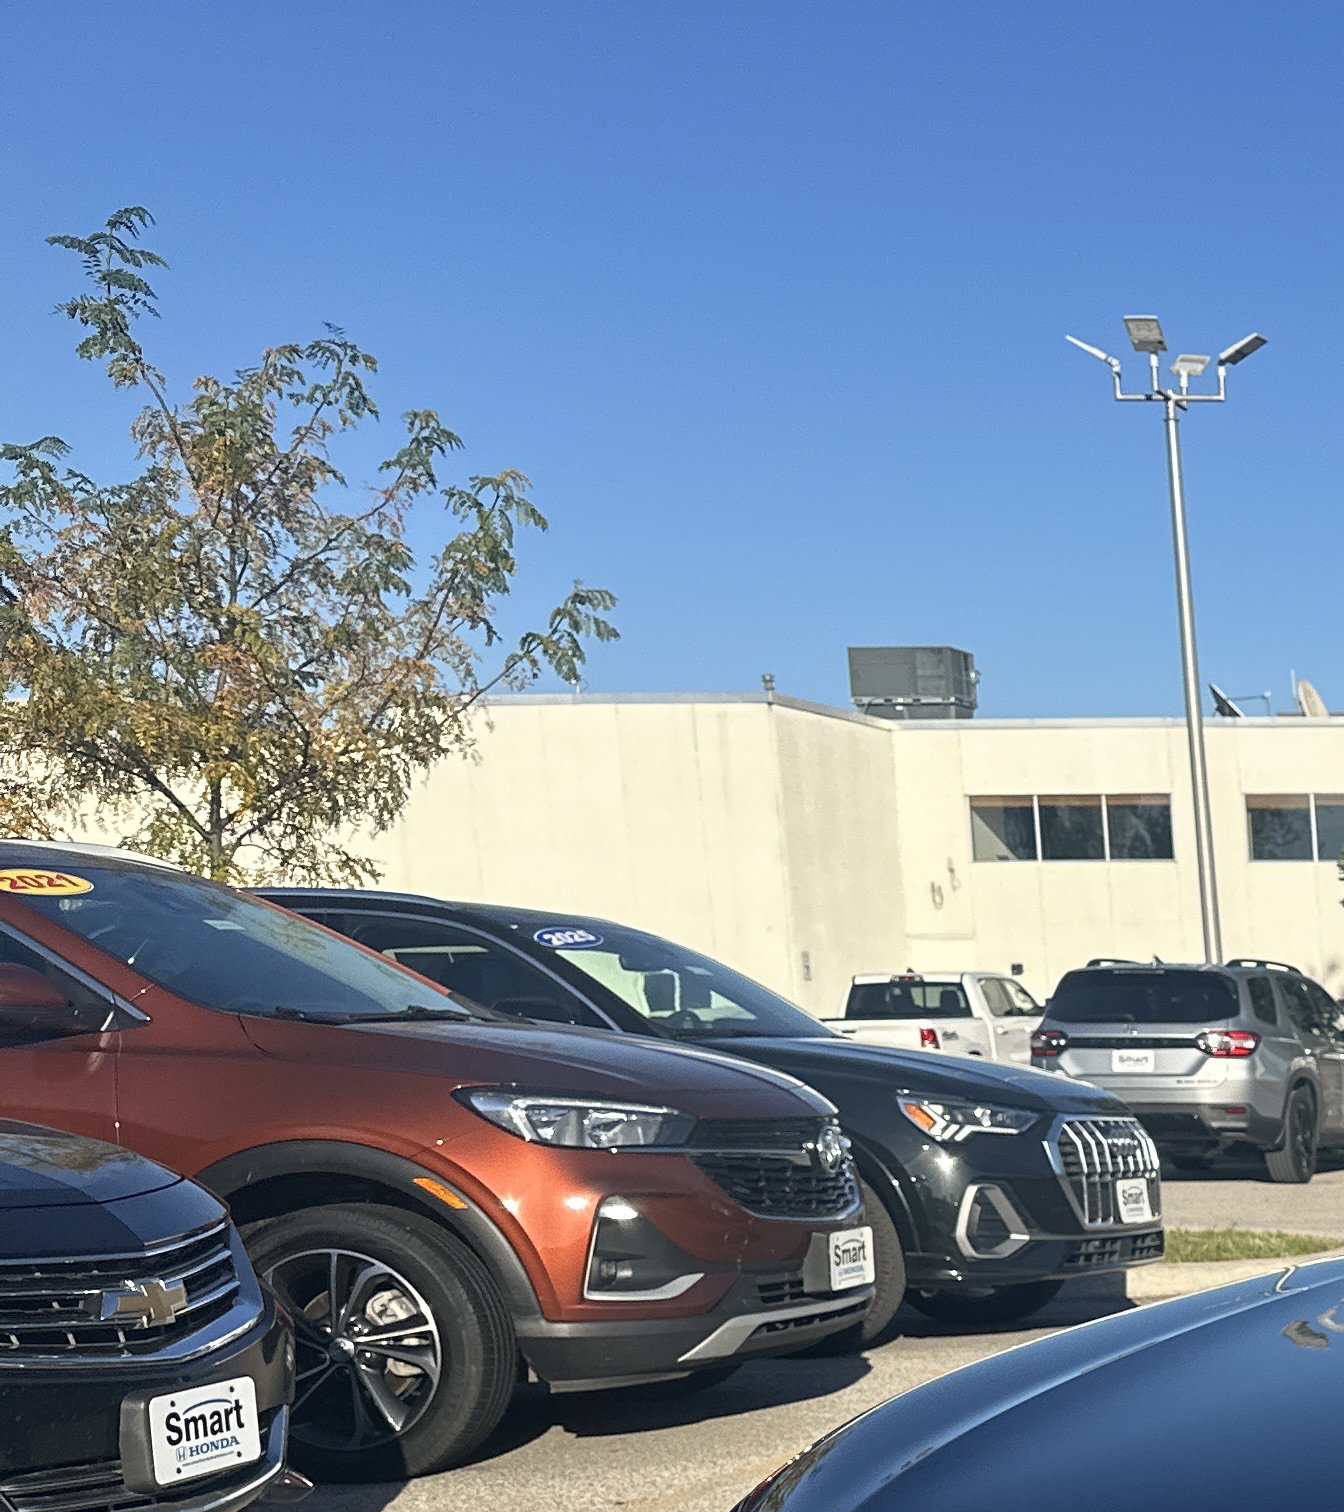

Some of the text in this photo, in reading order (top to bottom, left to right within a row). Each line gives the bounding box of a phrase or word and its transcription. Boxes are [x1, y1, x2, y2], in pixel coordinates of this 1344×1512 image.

[0, 874, 80, 890] 2021
[834, 1241, 867, 1267] Smart
[165, 1399, 245, 1446] Smart
[188, 1436, 240, 1457] HONDA
